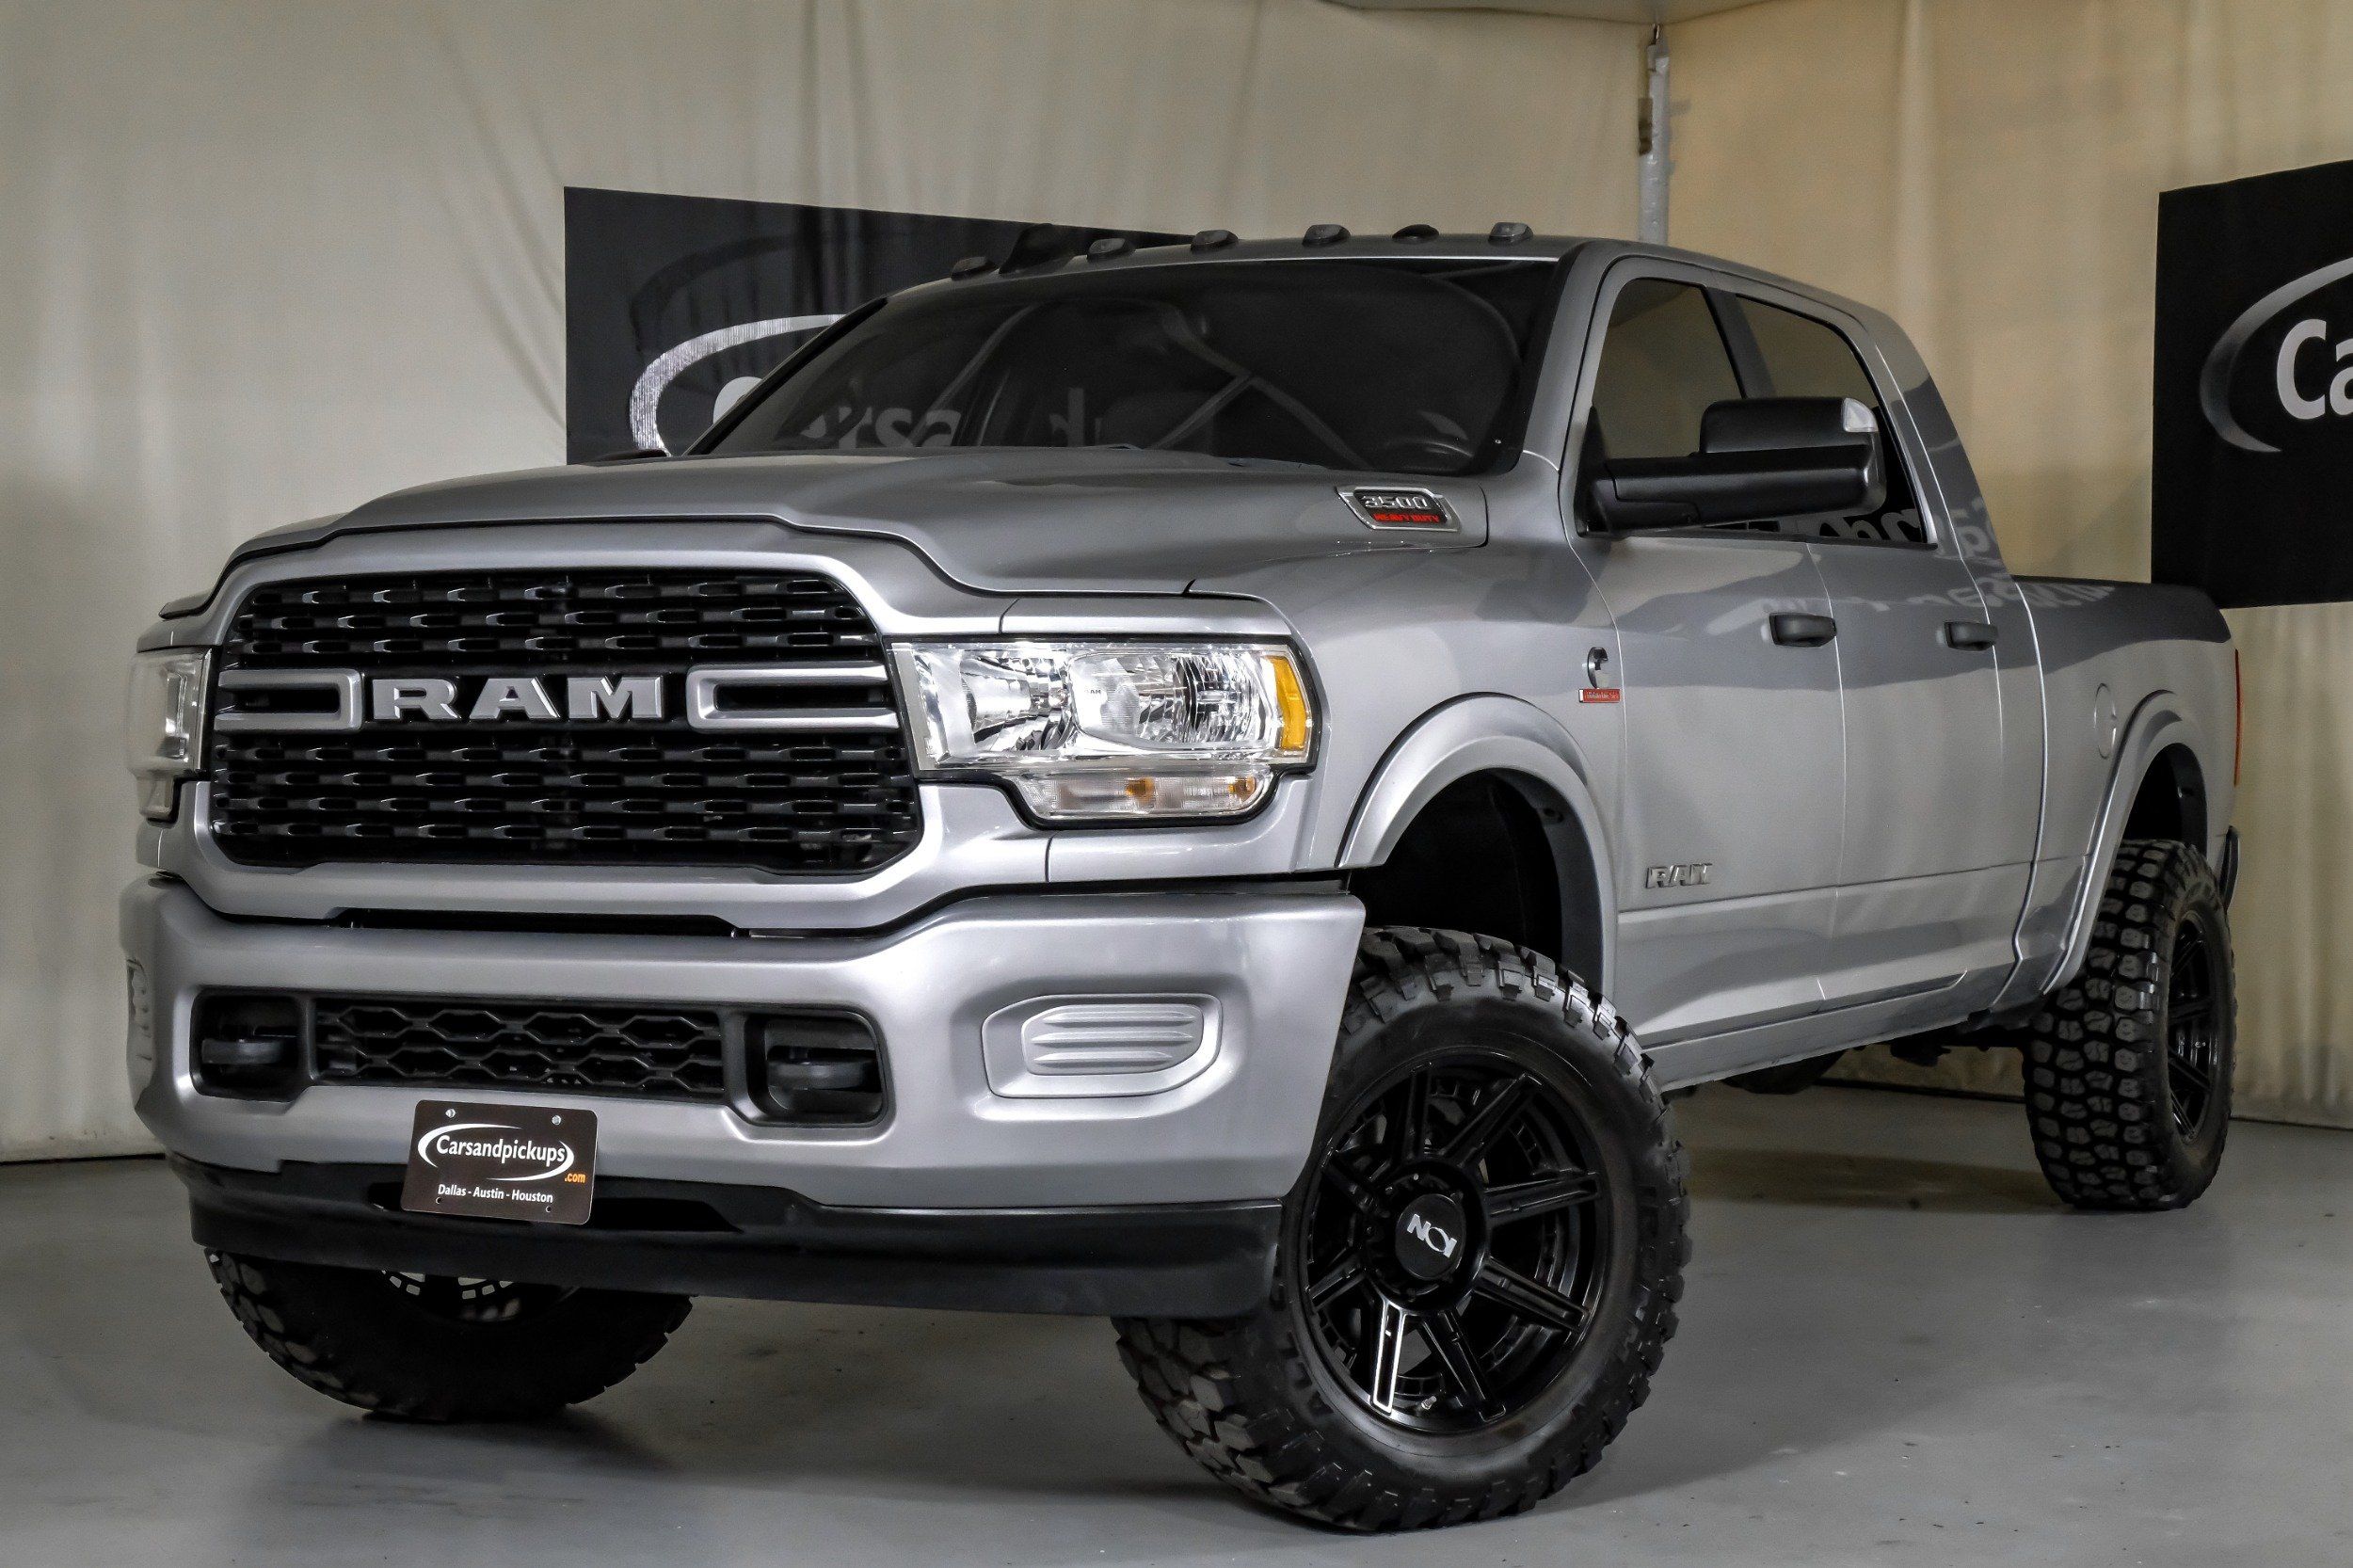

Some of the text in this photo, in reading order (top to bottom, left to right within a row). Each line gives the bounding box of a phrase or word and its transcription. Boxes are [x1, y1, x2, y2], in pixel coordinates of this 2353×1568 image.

[372, 675, 663, 720] RAM
[1645, 862, 1712, 888] RAM
[436, 1134, 566, 1168] Carsandpickups
[564, 1172, 586, 1184] .com
[438, 1184, 466, 1196] Dallas
[472, 1186, 504, 1200] Austin
[511, 1190, 553, 1204] Houston
